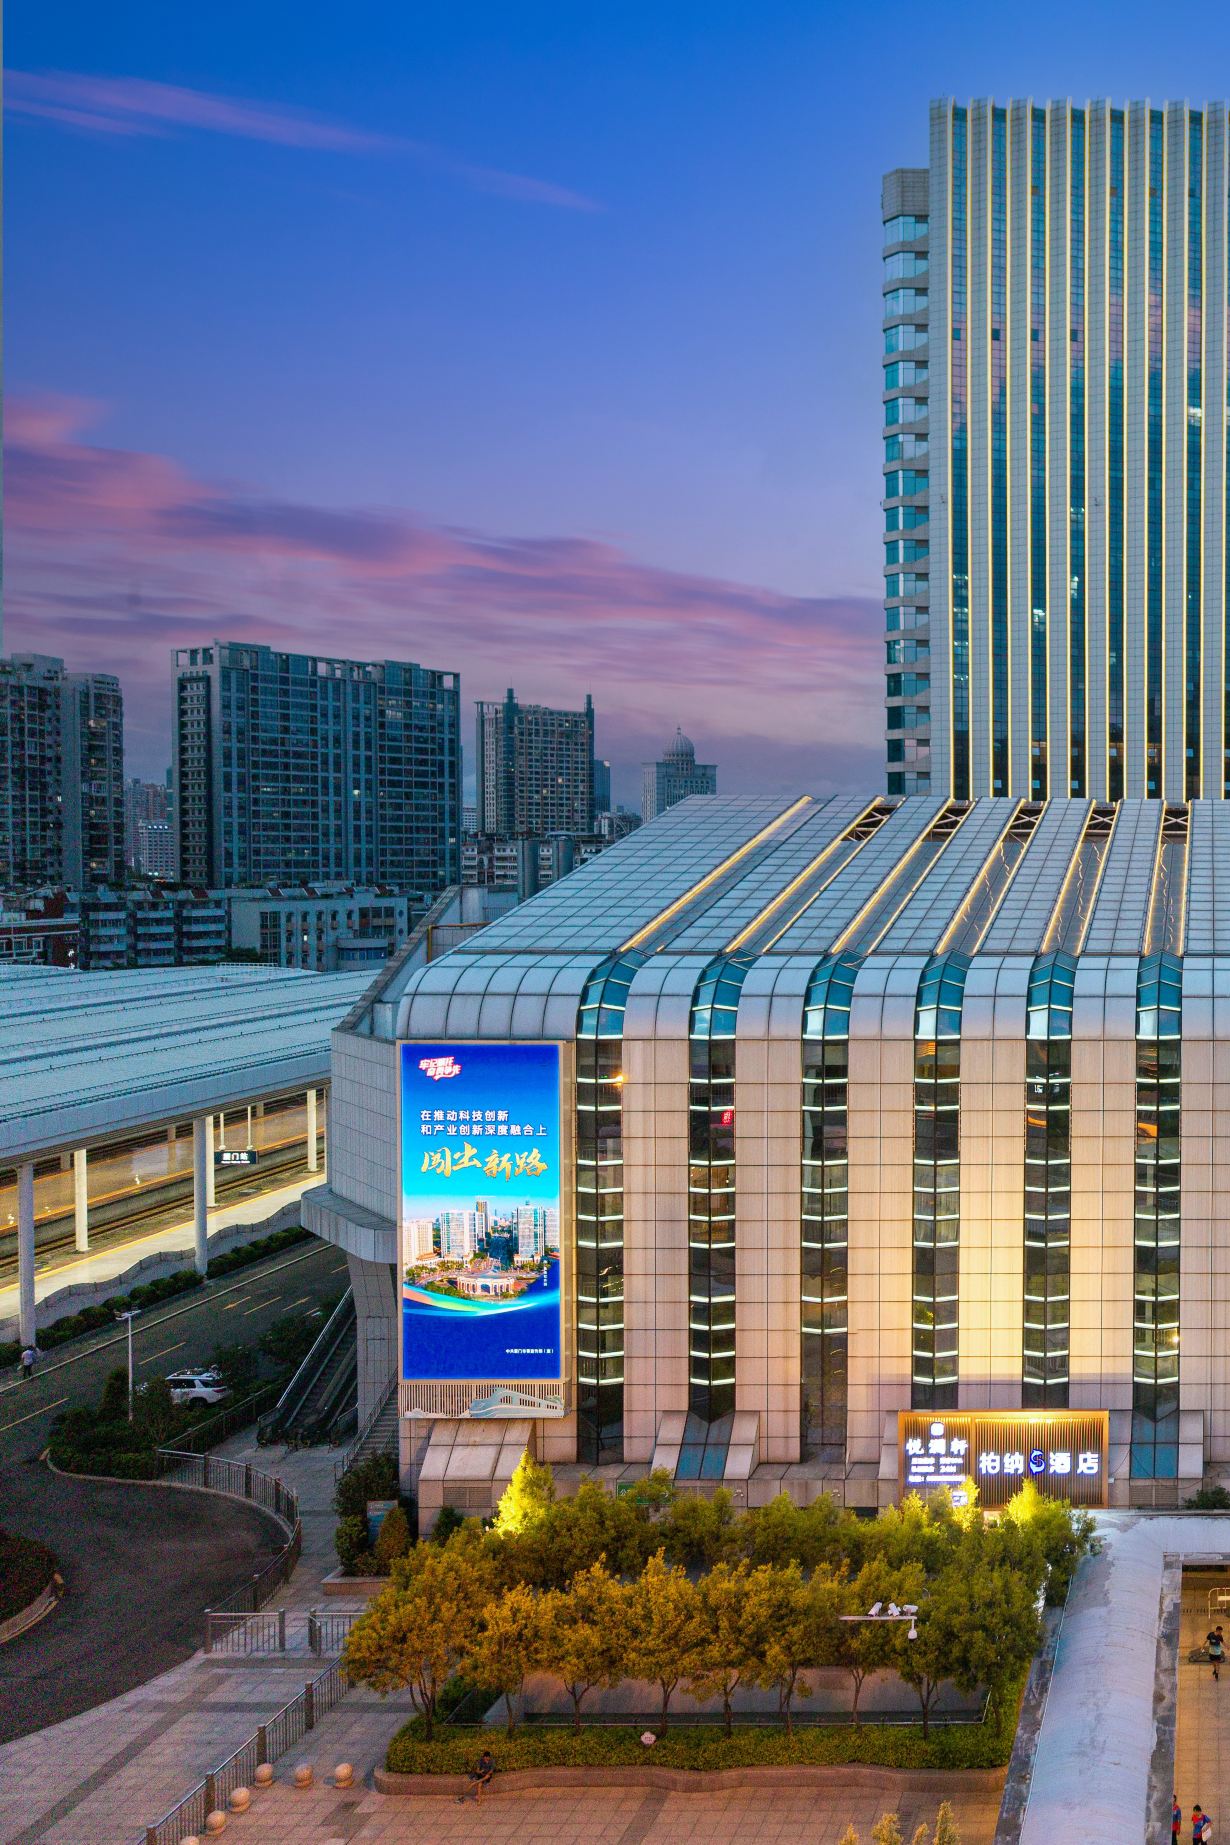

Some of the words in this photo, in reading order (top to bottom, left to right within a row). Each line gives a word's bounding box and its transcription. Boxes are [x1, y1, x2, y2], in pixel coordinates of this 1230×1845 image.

[420, 1110, 508, 1121] 在推动科技创新
[420, 1124, 547, 1135] 和产业创新深度融合上
[421, 1141, 548, 1181] 闯出新路
